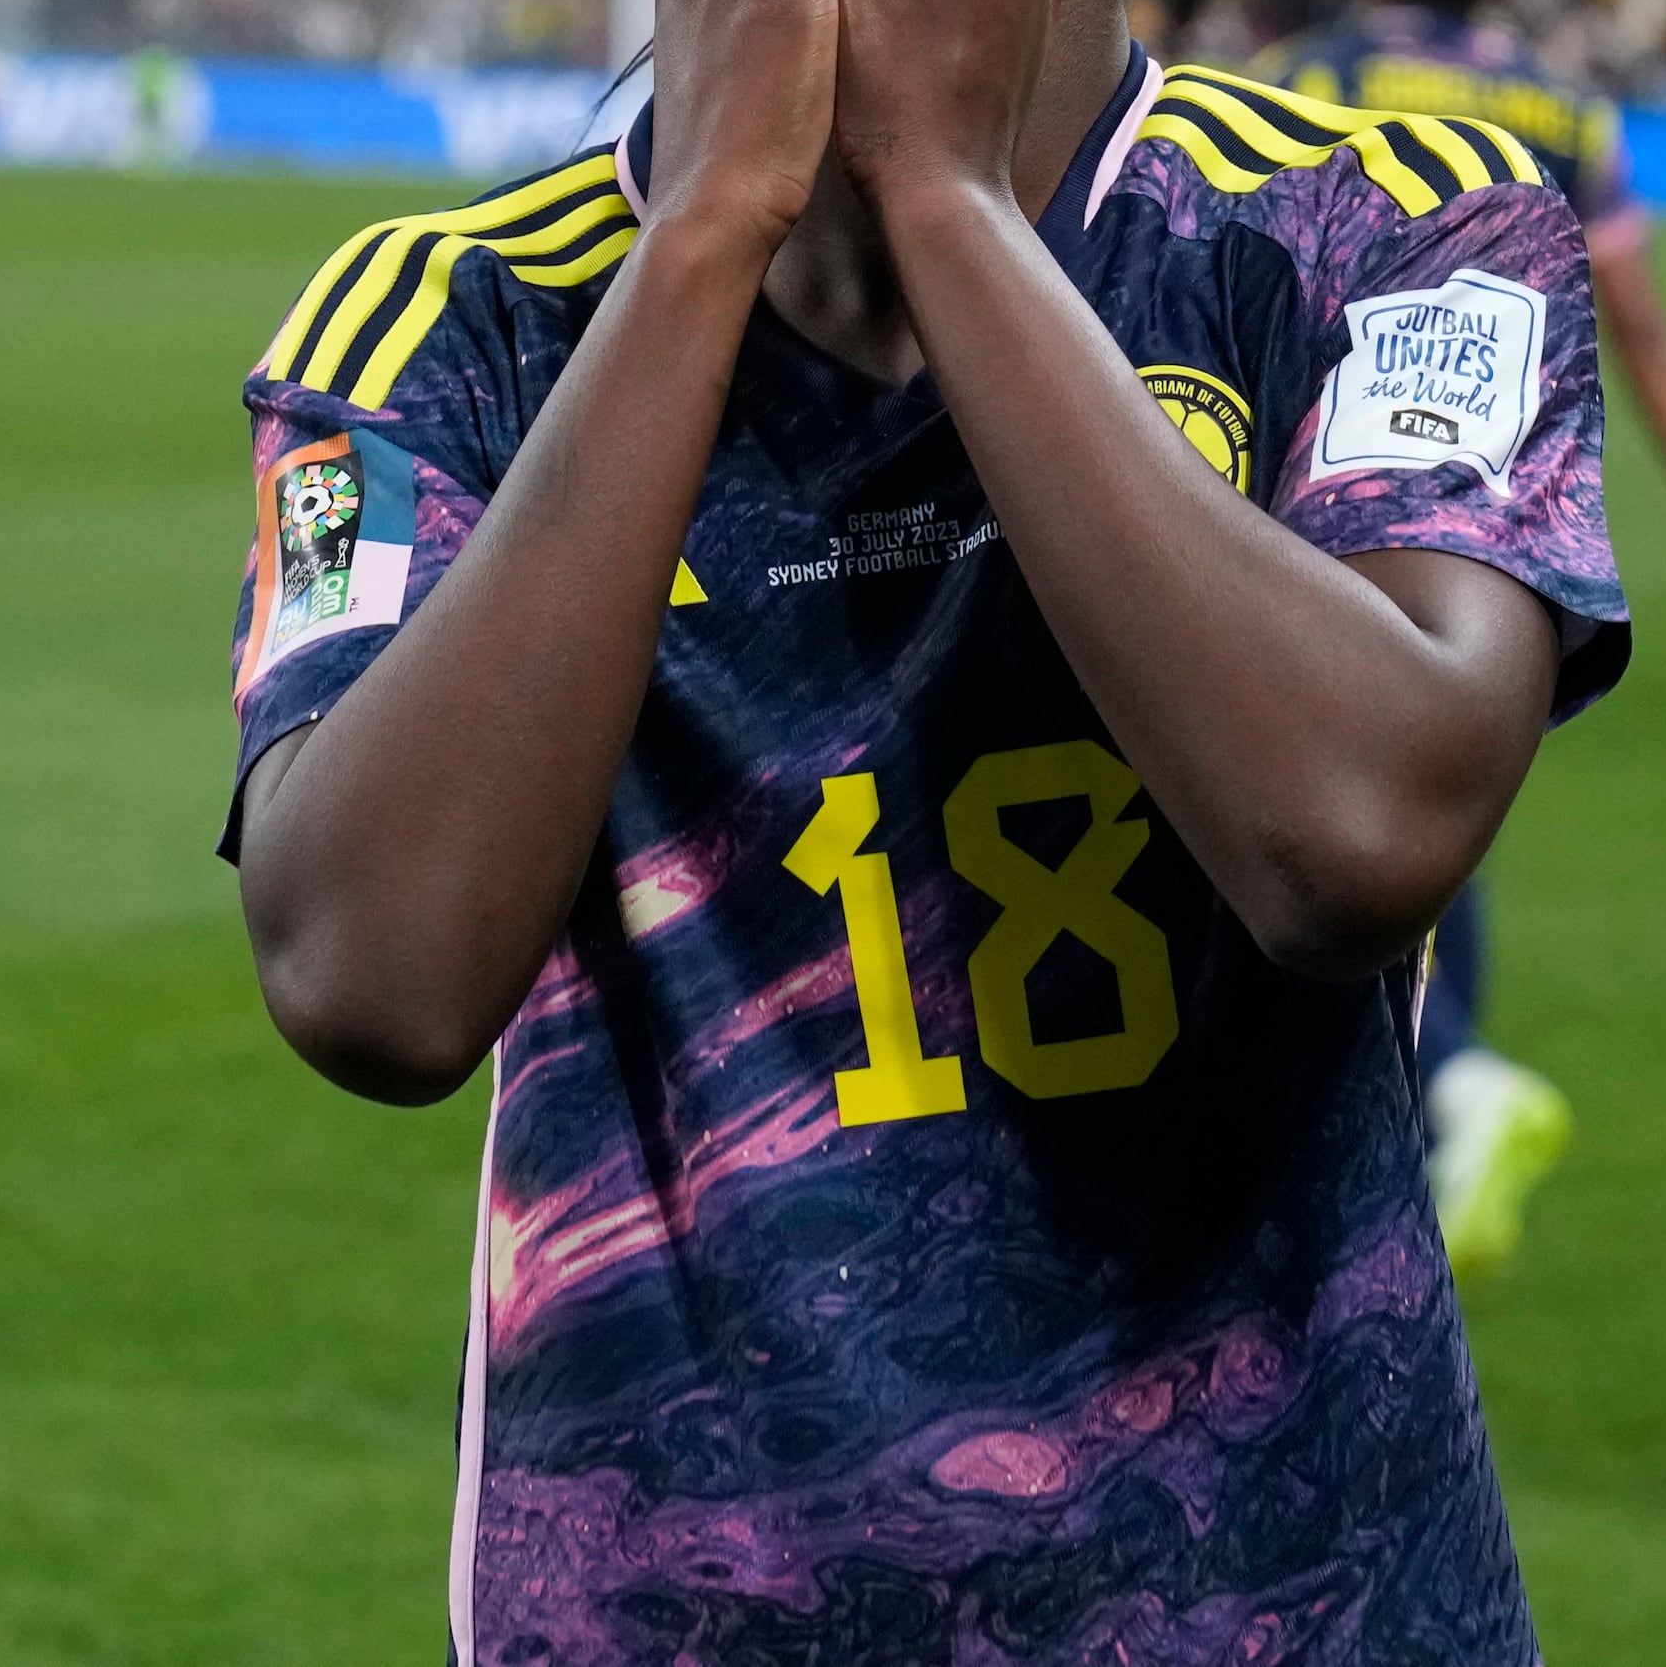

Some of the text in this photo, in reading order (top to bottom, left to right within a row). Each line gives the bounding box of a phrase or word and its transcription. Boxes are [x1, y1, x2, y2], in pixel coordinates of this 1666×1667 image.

[1375, 333, 1497, 383] UNITES
[1196, 388, 1216, 407] DE
[1413, 371, 1497, 422] World
[1399, 412, 1451, 441] FIFA
[847, 501, 935, 532] GERMANY
[767, 520, 1006, 587] SYDNEY FOOTBALL STADIU
[829, 519, 961, 557] 30 JULY 2023
[284, 559, 301, 584] FIFA
[309, 560, 332, 579] CUP
[781, 739, 1180, 1128] 18
